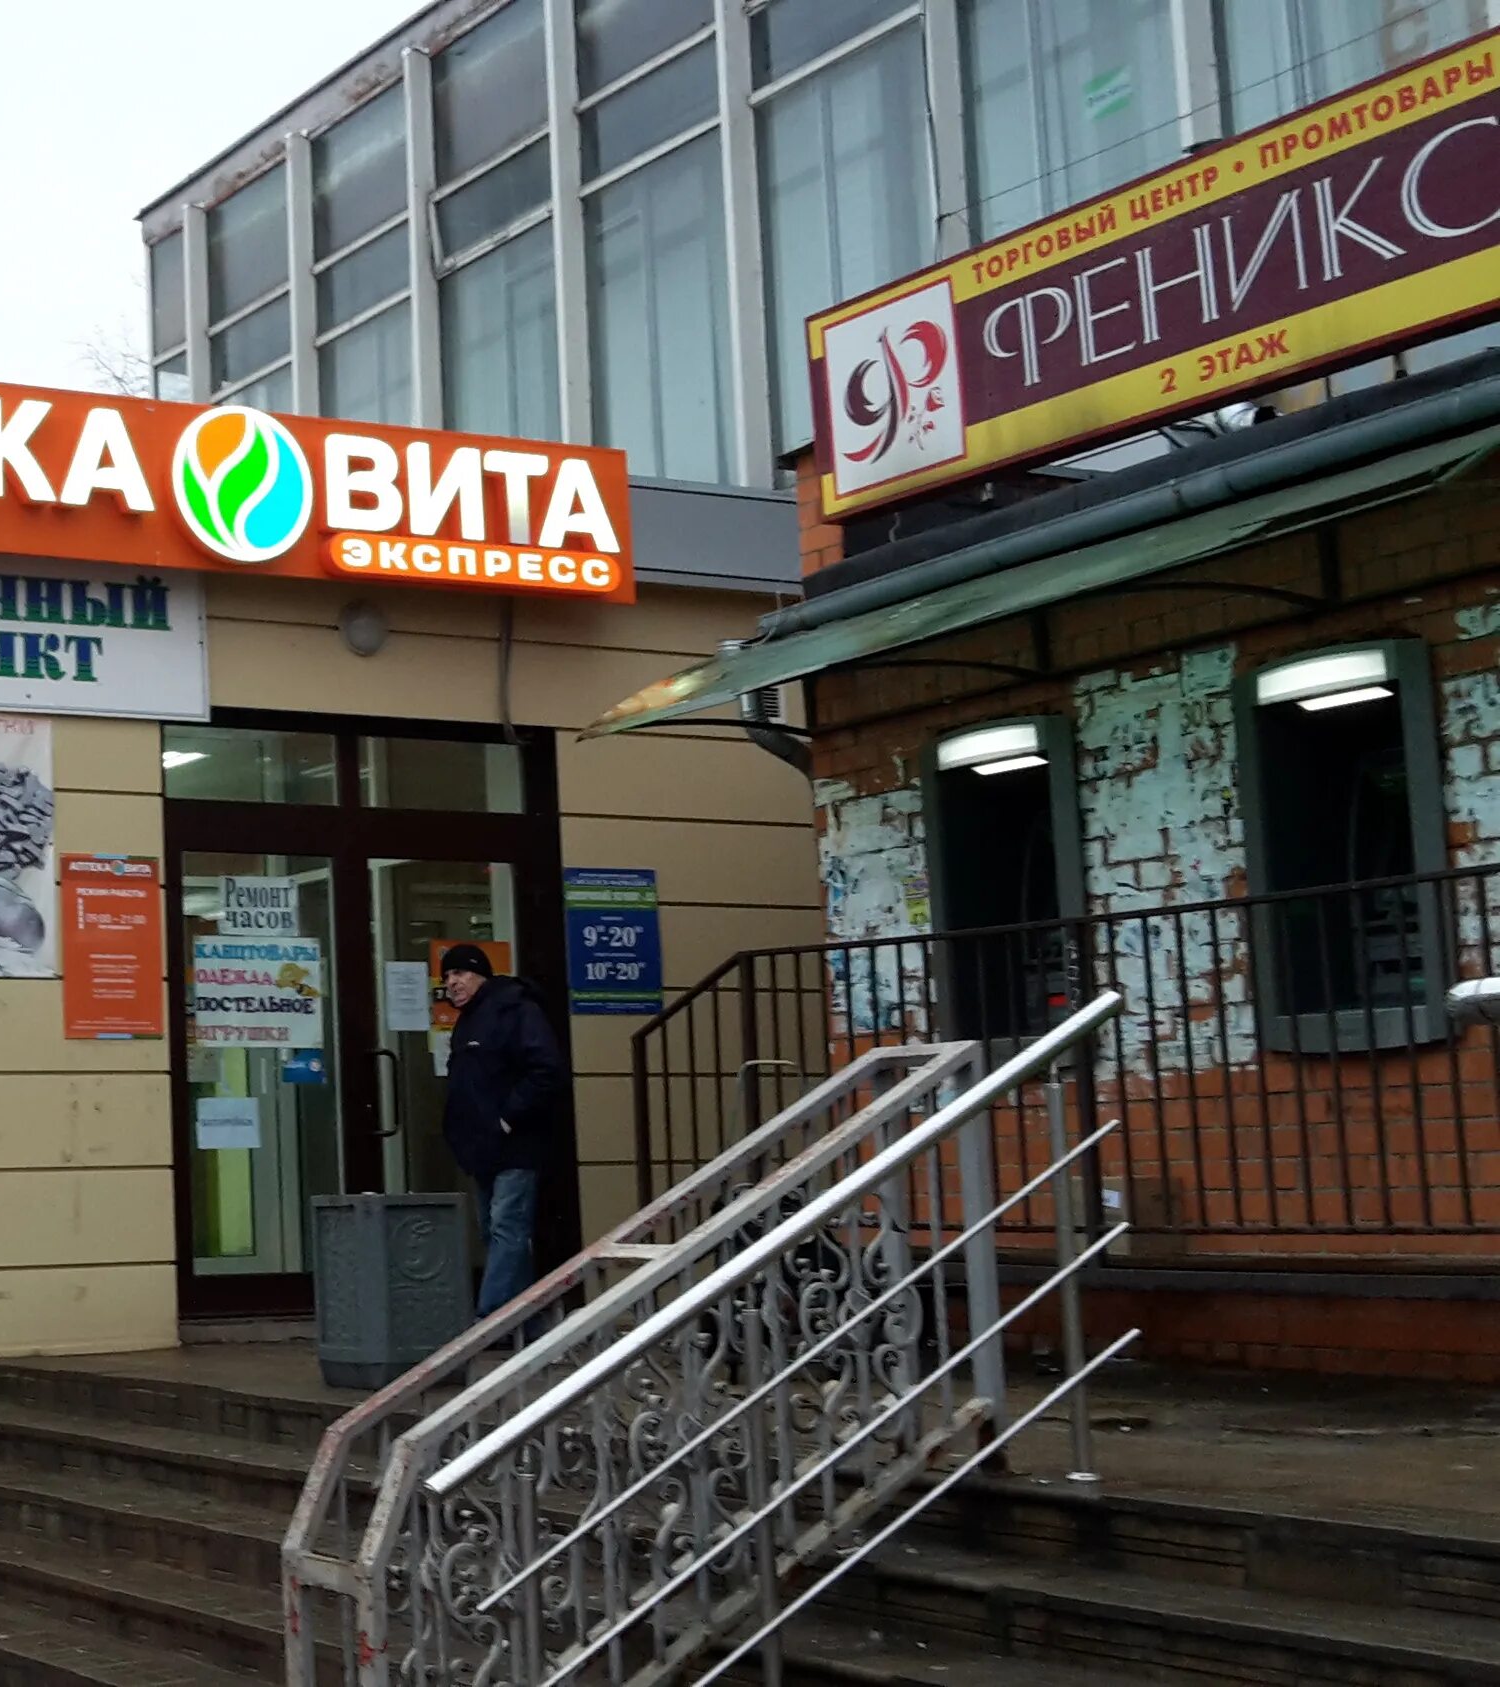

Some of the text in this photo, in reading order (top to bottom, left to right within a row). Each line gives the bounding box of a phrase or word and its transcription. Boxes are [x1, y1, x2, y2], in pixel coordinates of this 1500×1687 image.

[972, 51, 1495, 285] ТОРГОВЫЙ ЦЕНТР ПРОМТОВАРЫ
[982, 115, 1500, 387] ФЕНИКС
[1158, 328, 1290, 395] 2 ЭТАЖ
[324, 433, 621, 554] ВИТА
[341, 538, 611, 587] ЭКСПРЕСС
[224, 876, 292, 909] Ремонт
[225, 911, 294, 929] часов
